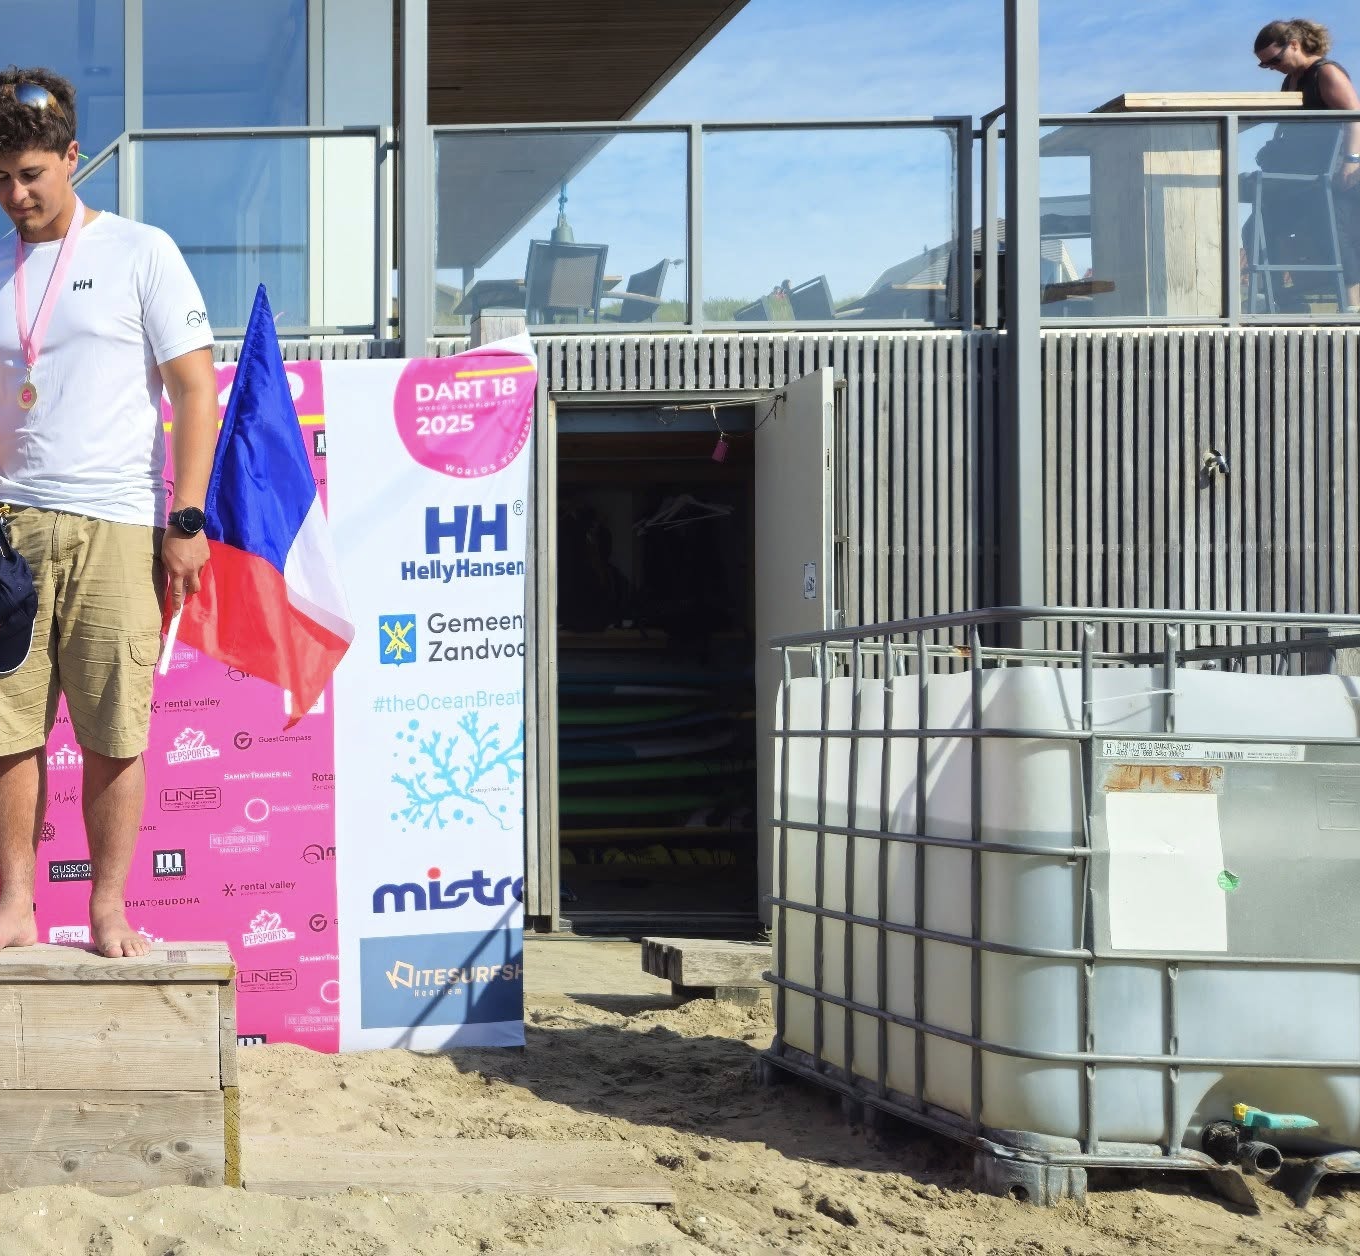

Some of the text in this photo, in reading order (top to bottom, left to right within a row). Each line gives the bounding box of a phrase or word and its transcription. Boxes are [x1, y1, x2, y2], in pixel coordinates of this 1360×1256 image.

[415, 377, 517, 402] DART 18
[416, 414, 475, 435] 2025
[425, 504, 508, 554] HH
[401, 558, 525, 583] HellyHansen
[427, 612, 525, 634] Gemeen
[164, 697, 221, 708] rental valley
[373, 690, 524, 713] #theOceanBreat
[258, 735, 312, 743] GuestCompass
[312, 772, 335, 782] Rota
[165, 789, 217, 802] LINES
[240, 880, 297, 891] rental valley
[125, 897, 200, 907] DHATOBUDDHA
[244, 929, 287, 945] PEPSPORTS
[240, 971, 292, 983] LINES
